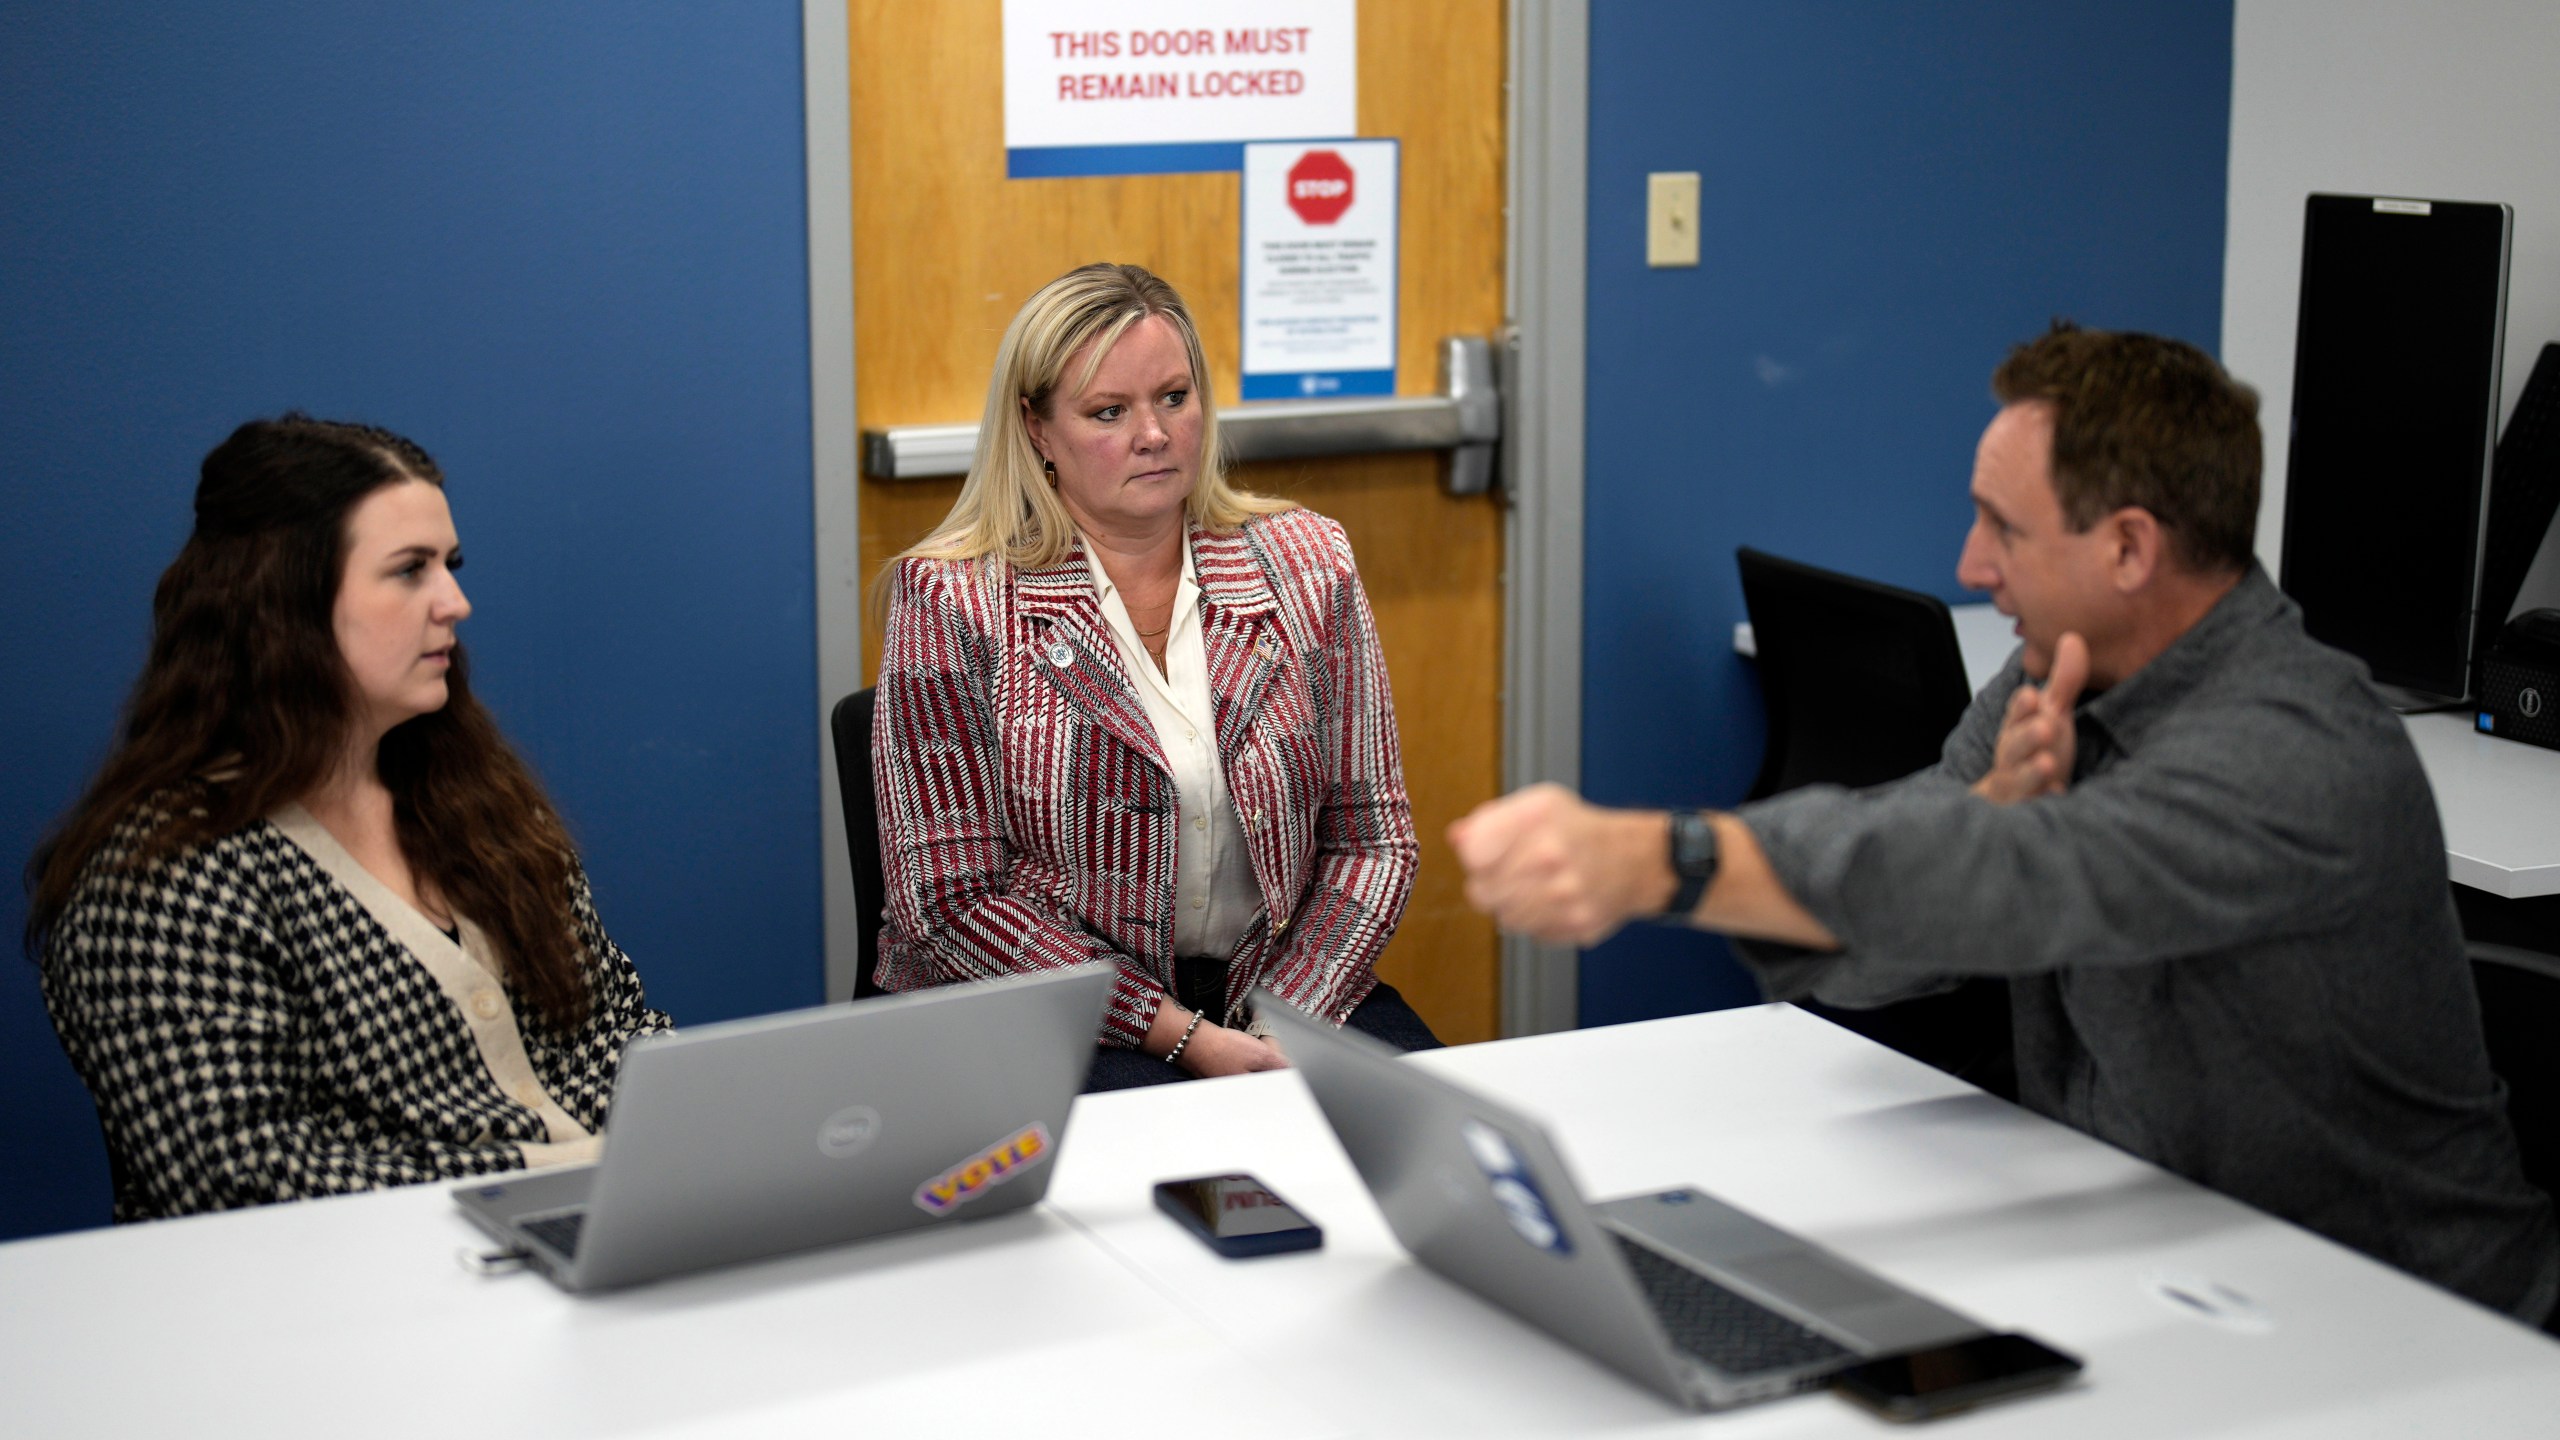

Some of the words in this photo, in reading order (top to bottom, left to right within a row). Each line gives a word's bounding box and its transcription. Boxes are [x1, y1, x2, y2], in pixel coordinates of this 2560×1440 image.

[1049, 32, 1121, 58] THIS
[1130, 30, 1215, 56] DOOR
[1224, 28, 1310, 54] MUST
[1058, 73, 1178, 100] REMAIN
[1188, 70, 1304, 97] LOCKED
[1294, 179, 1348, 199] STOP
[921, 1127, 1045, 1207] VOTE
